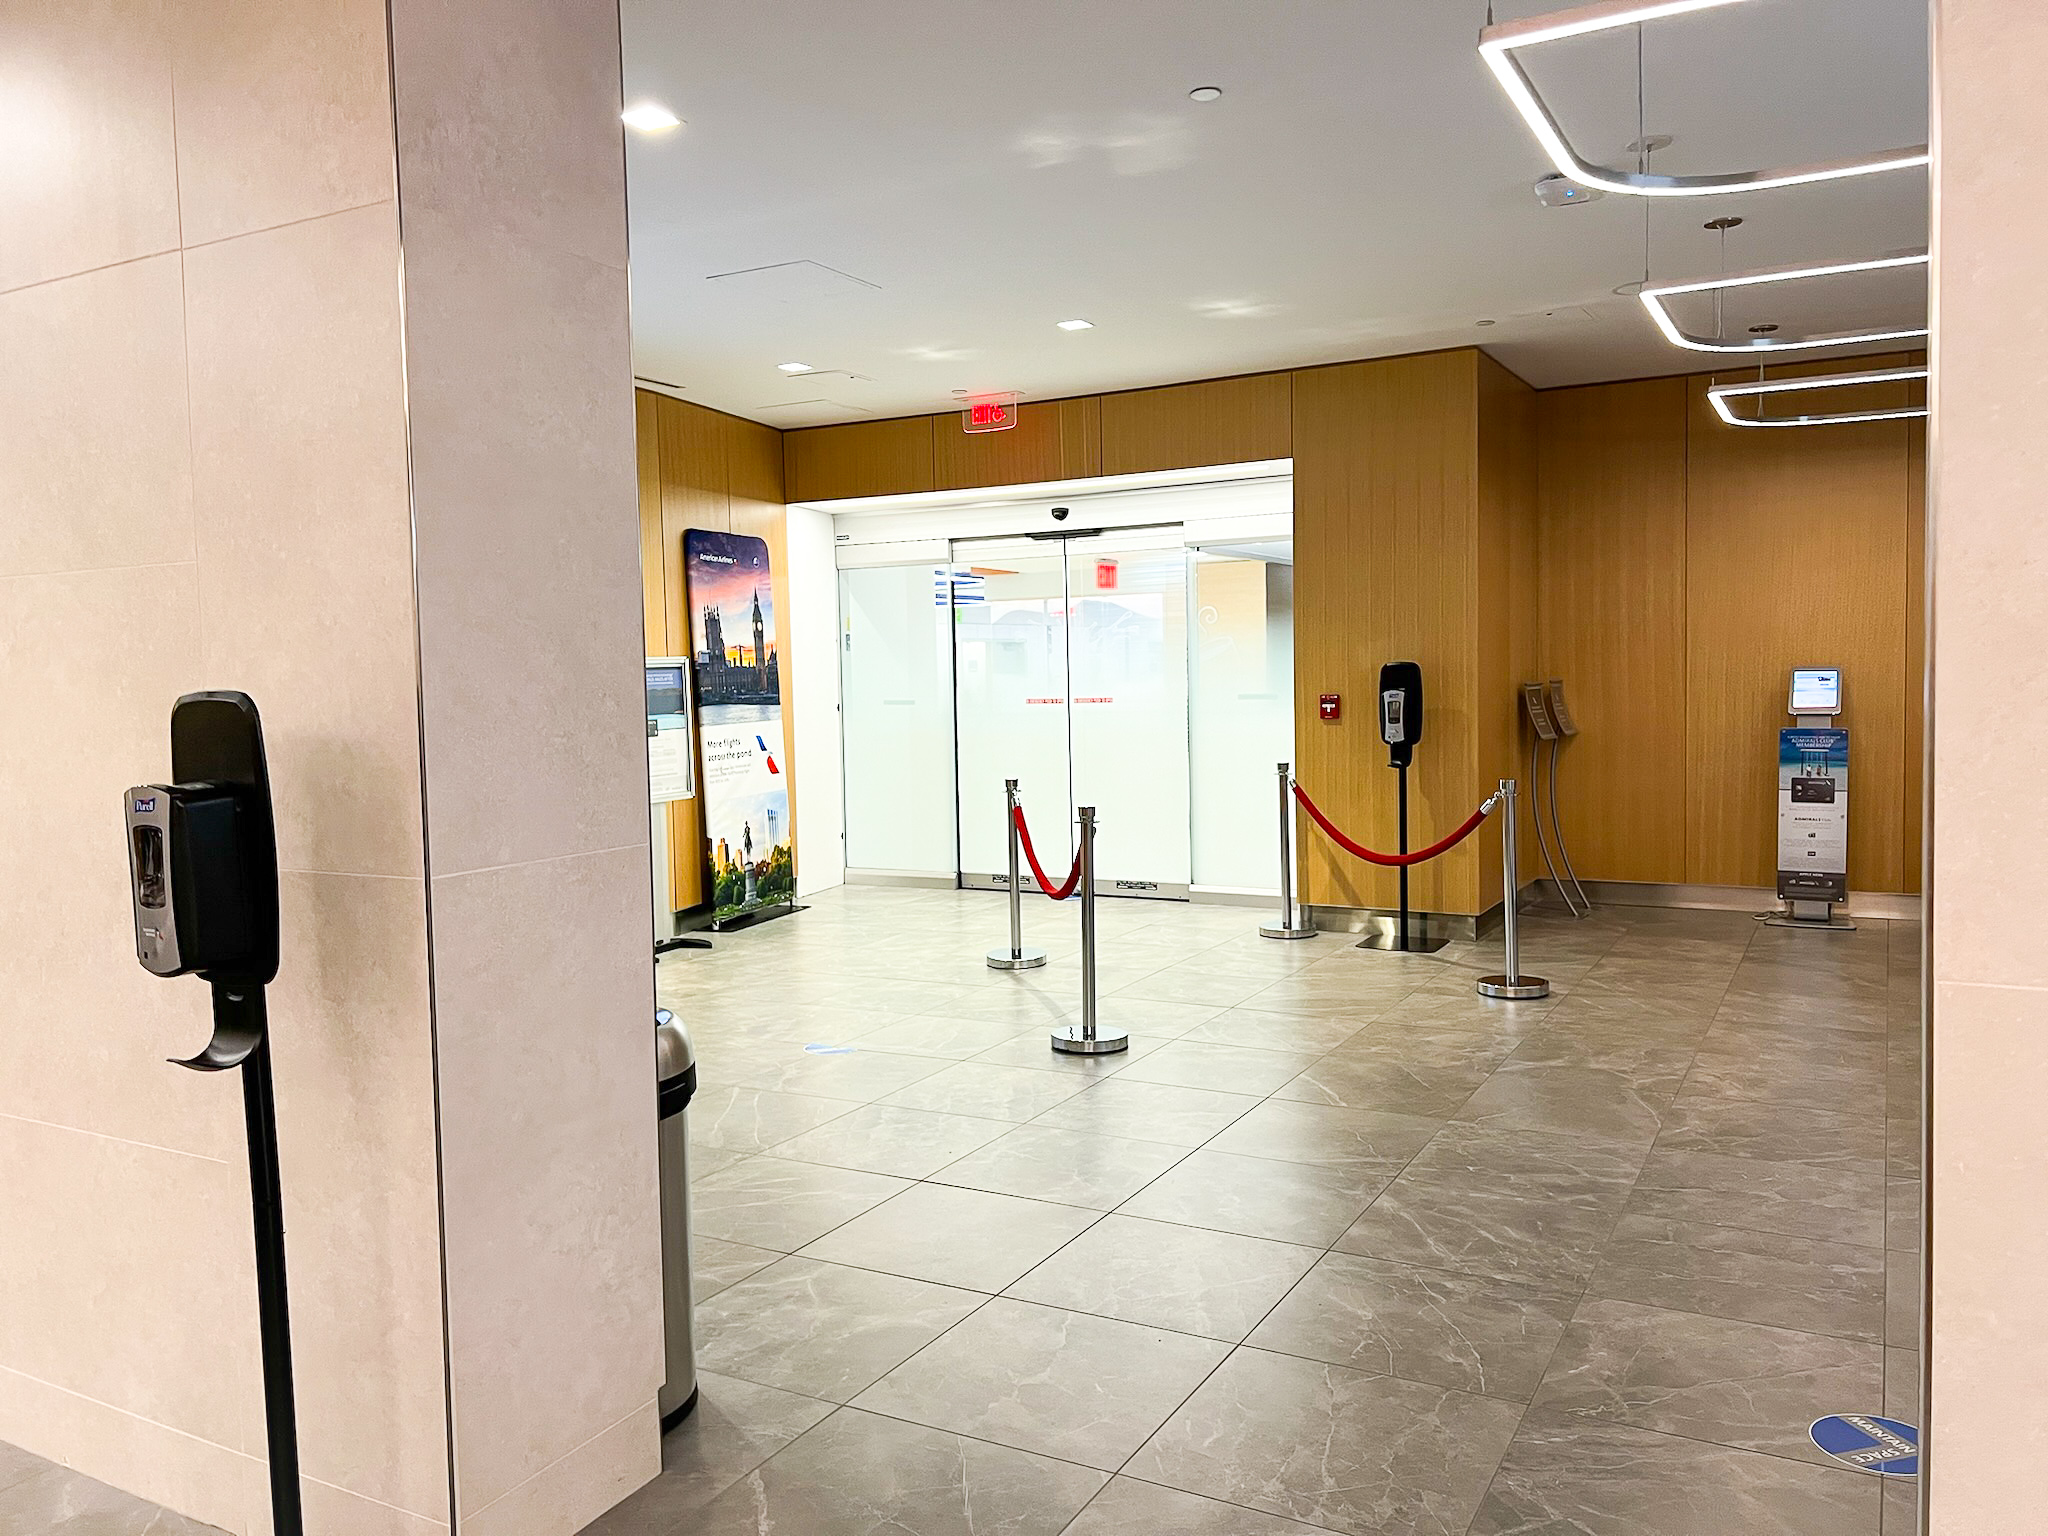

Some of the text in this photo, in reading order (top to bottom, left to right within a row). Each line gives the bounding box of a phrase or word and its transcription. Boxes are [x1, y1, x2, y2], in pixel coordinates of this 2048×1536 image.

[723, 738, 741, 749] flights
[708, 753, 726, 761] across
[736, 749, 752, 760] pond
[1847, 1416, 1916, 1454] MAINTAIN
[1850, 1447, 1901, 1464] SPACE
